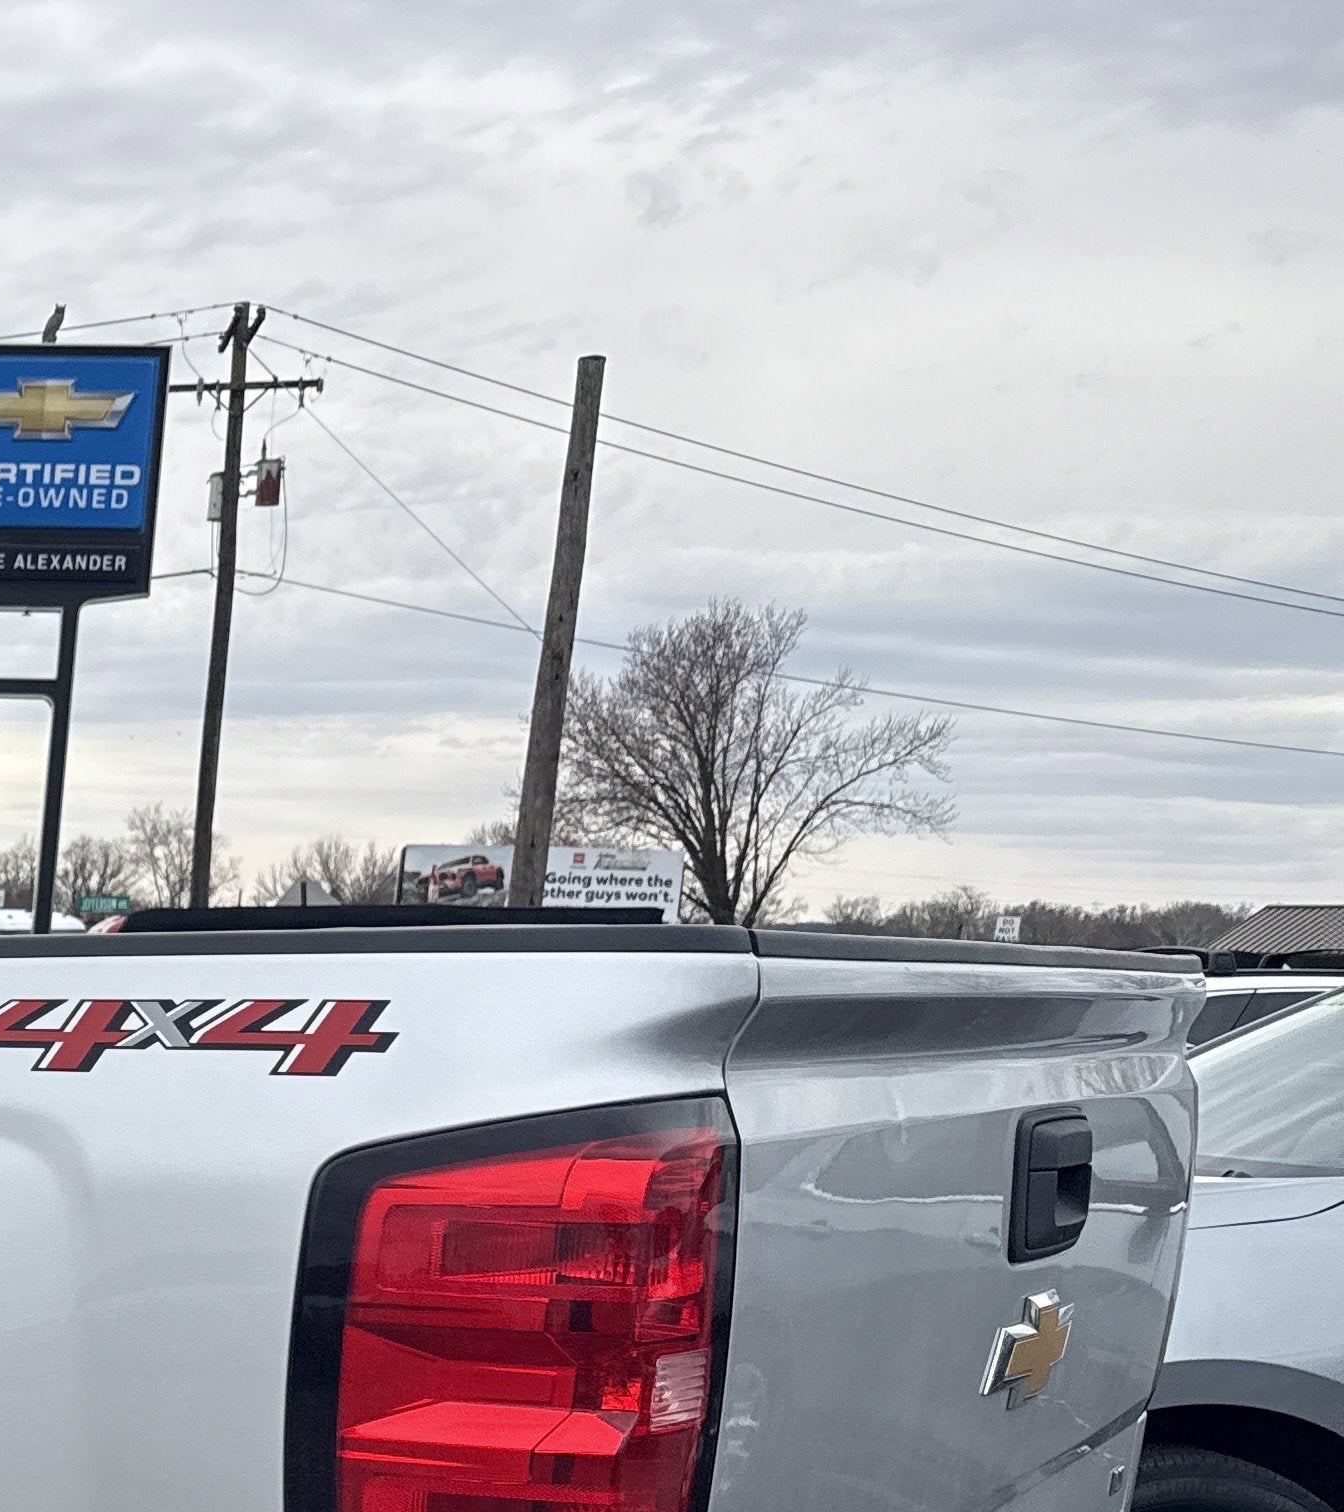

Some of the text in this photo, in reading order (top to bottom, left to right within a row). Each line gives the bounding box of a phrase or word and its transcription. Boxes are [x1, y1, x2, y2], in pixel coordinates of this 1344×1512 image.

[13, 554, 127, 572] ALEXANDER
[545, 871, 673, 889] Going where the
[585, 890, 621, 903] guys
